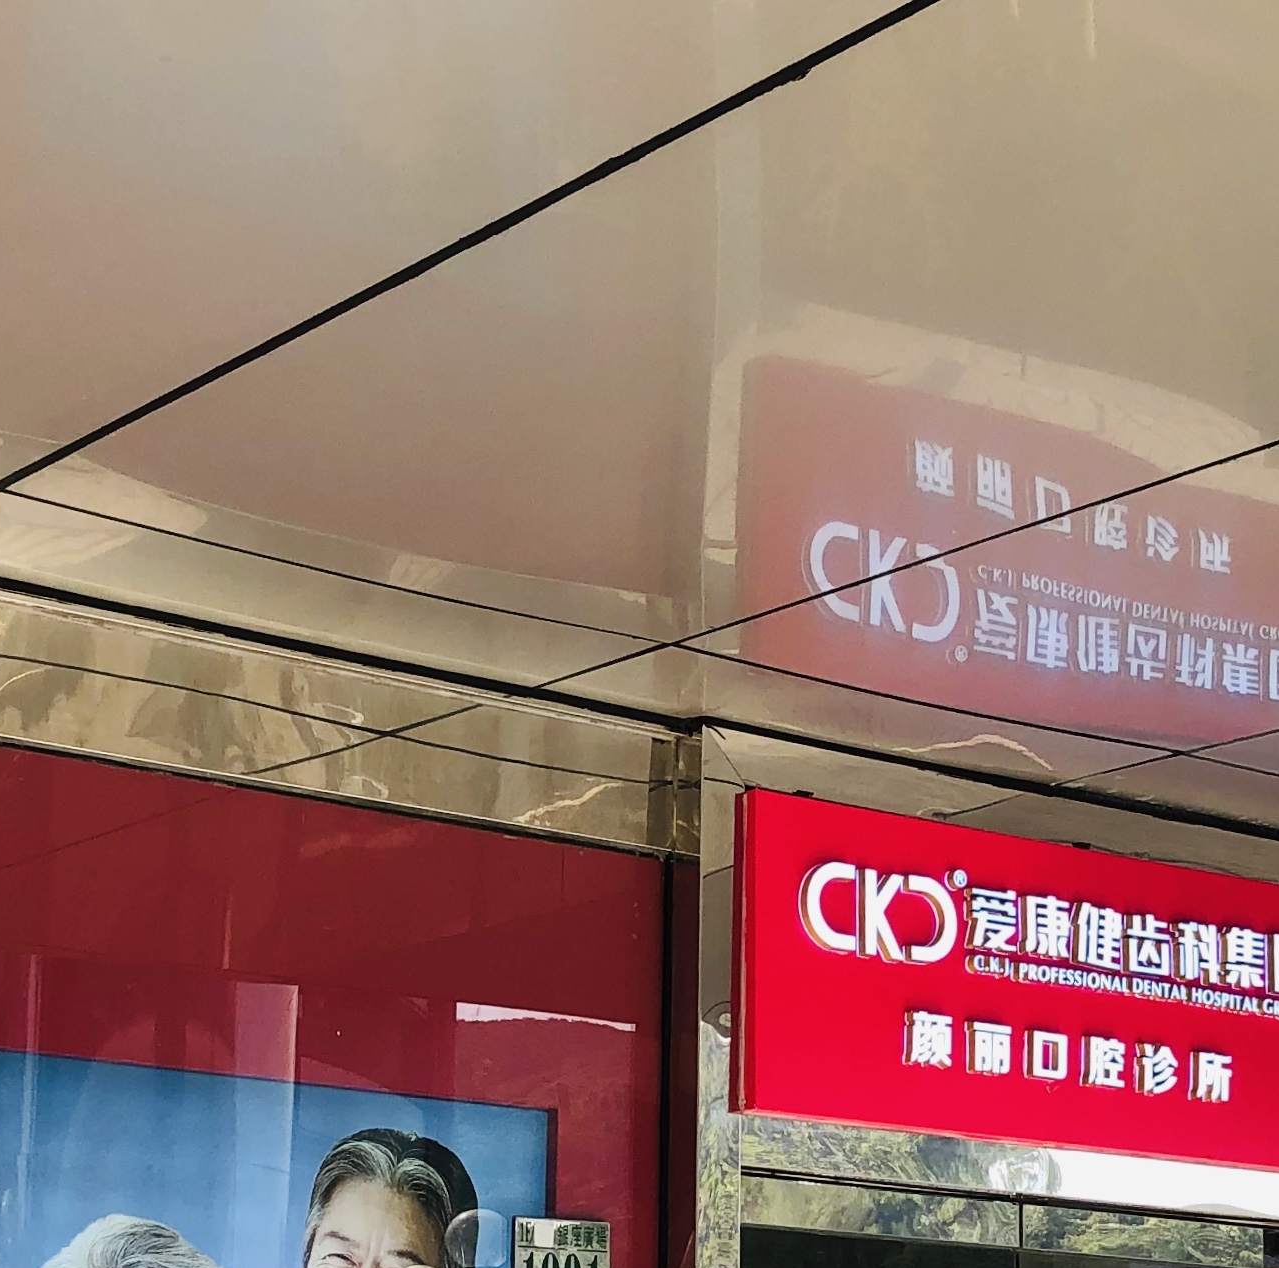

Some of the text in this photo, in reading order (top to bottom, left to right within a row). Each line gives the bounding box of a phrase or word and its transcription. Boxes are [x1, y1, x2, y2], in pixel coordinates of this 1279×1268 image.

[1020, 962, 1132, 994] PROFESSIONAL
[1132, 976, 1188, 1001] DENTAL
[1191, 987, 1259, 1015] HOSPITAL
[902, 1010, 1233, 1102] 颜丽口腔诊所
